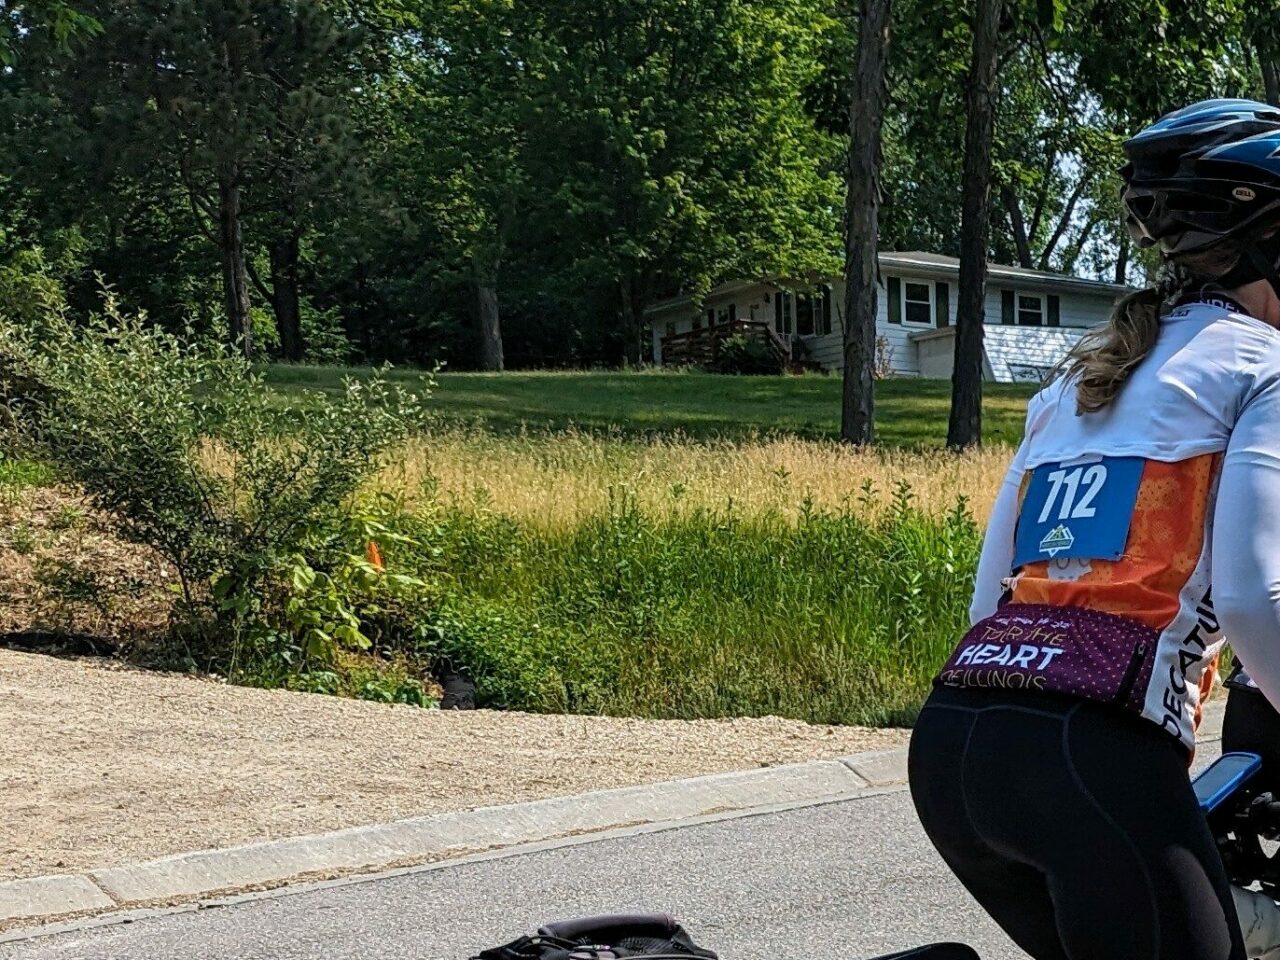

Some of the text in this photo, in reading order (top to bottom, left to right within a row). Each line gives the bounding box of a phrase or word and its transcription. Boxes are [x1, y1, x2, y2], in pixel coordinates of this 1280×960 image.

[1037, 464, 1107, 523] 712
[955, 643, 1064, 671] HEART
[962, 669, 1048, 690] ILLINOIS
